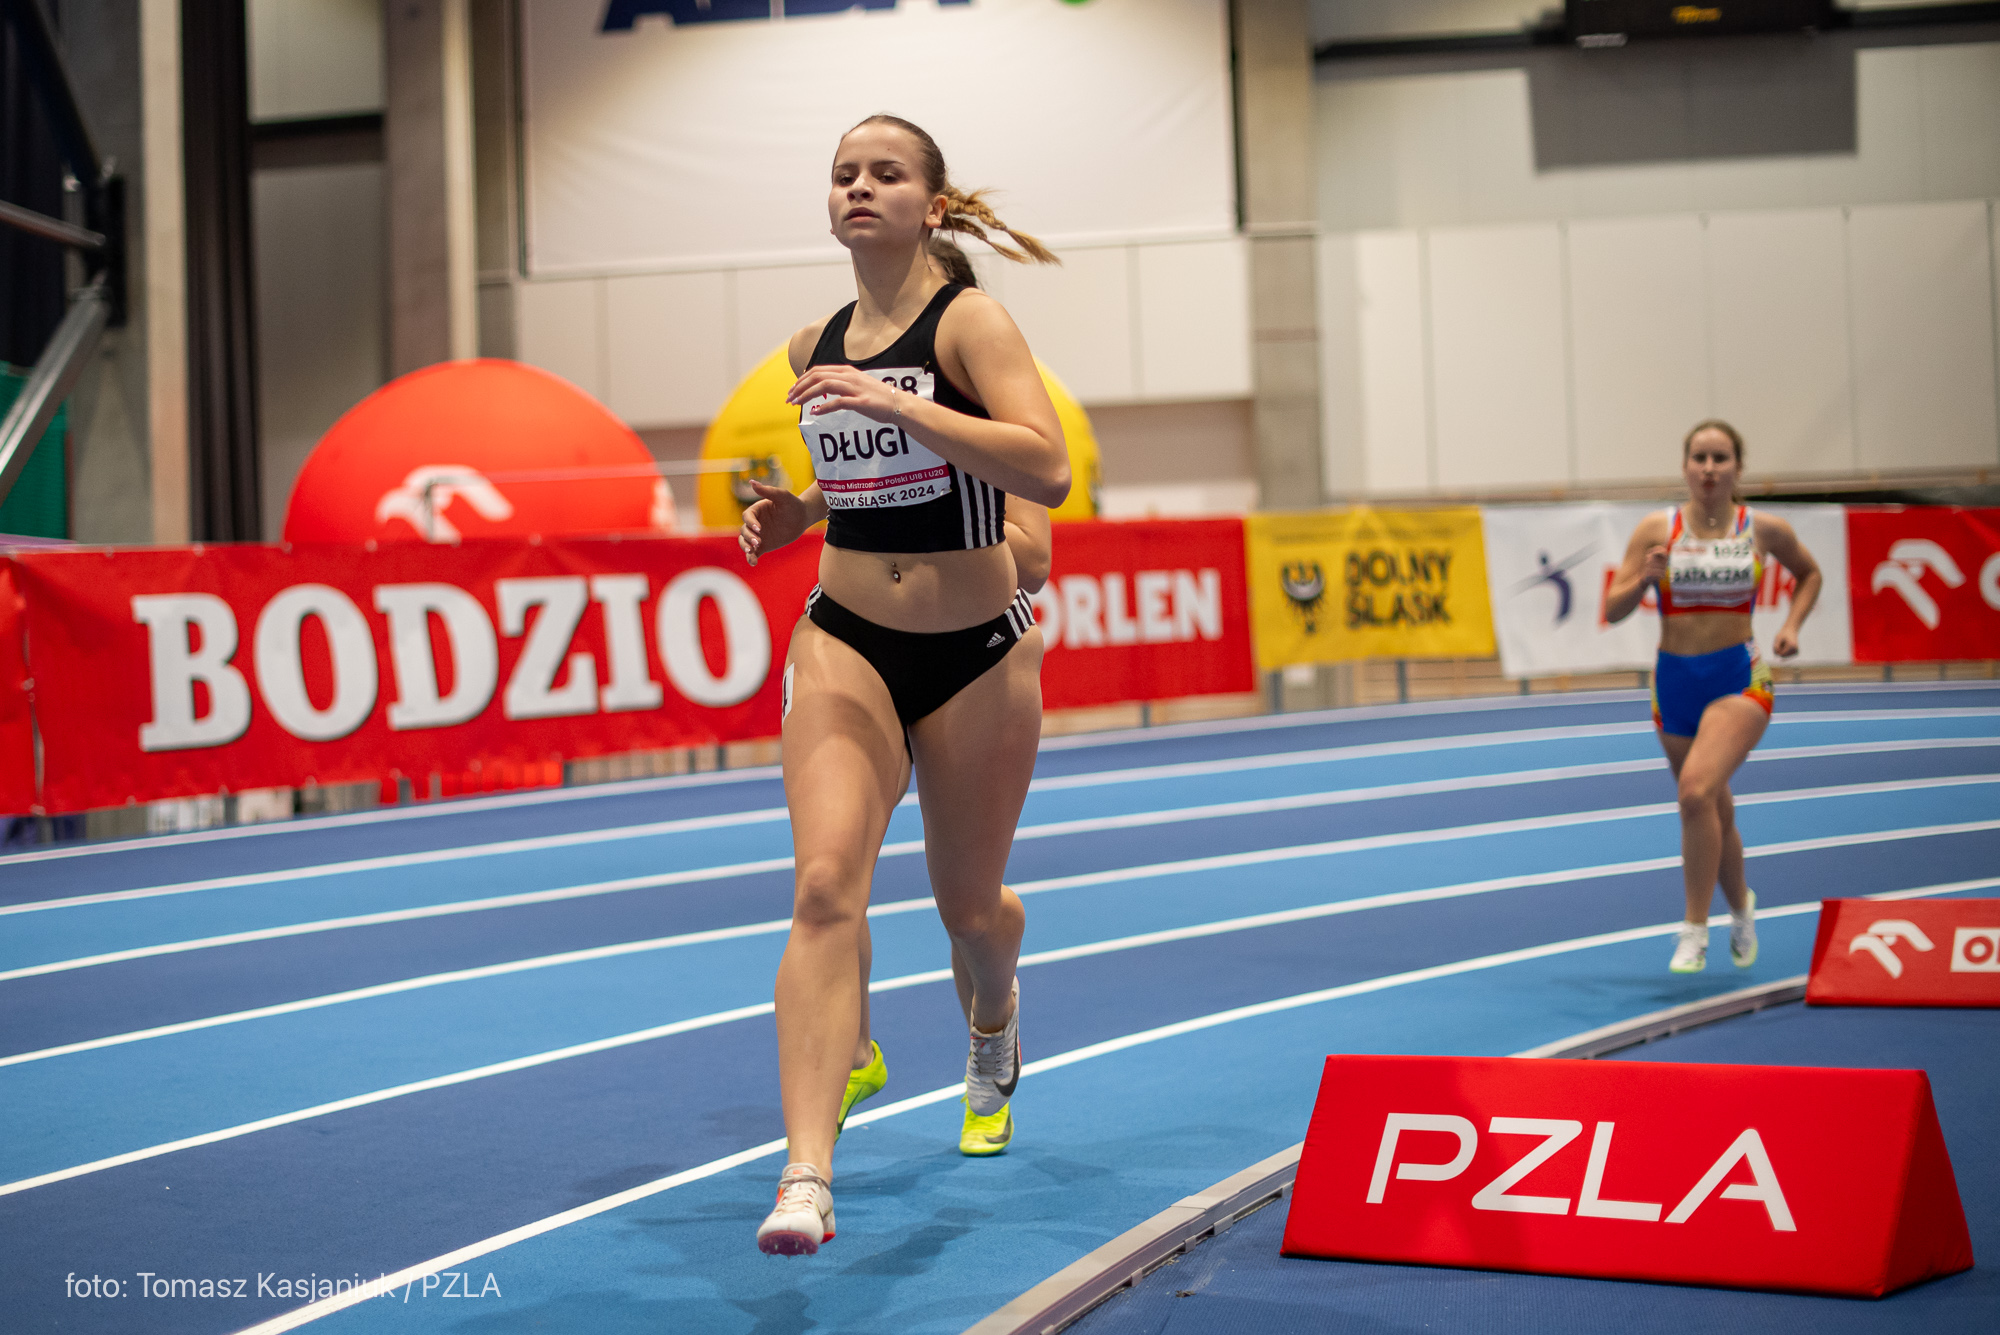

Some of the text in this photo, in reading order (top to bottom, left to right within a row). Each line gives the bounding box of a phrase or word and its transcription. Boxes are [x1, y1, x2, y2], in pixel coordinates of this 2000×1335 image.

[818, 425, 909, 463] DŁUGI
[828, 485, 936, 509] DOLNY ŚLĄSK 2024
[846, 480, 884, 490] Mistrzostwa
[885, 476, 908, 486] Polski
[909, 473, 923, 481] U18
[929, 468, 944, 477] U20
[131, 566, 772, 753] BODZIO
[1366, 1112, 1798, 1232] PZLA
